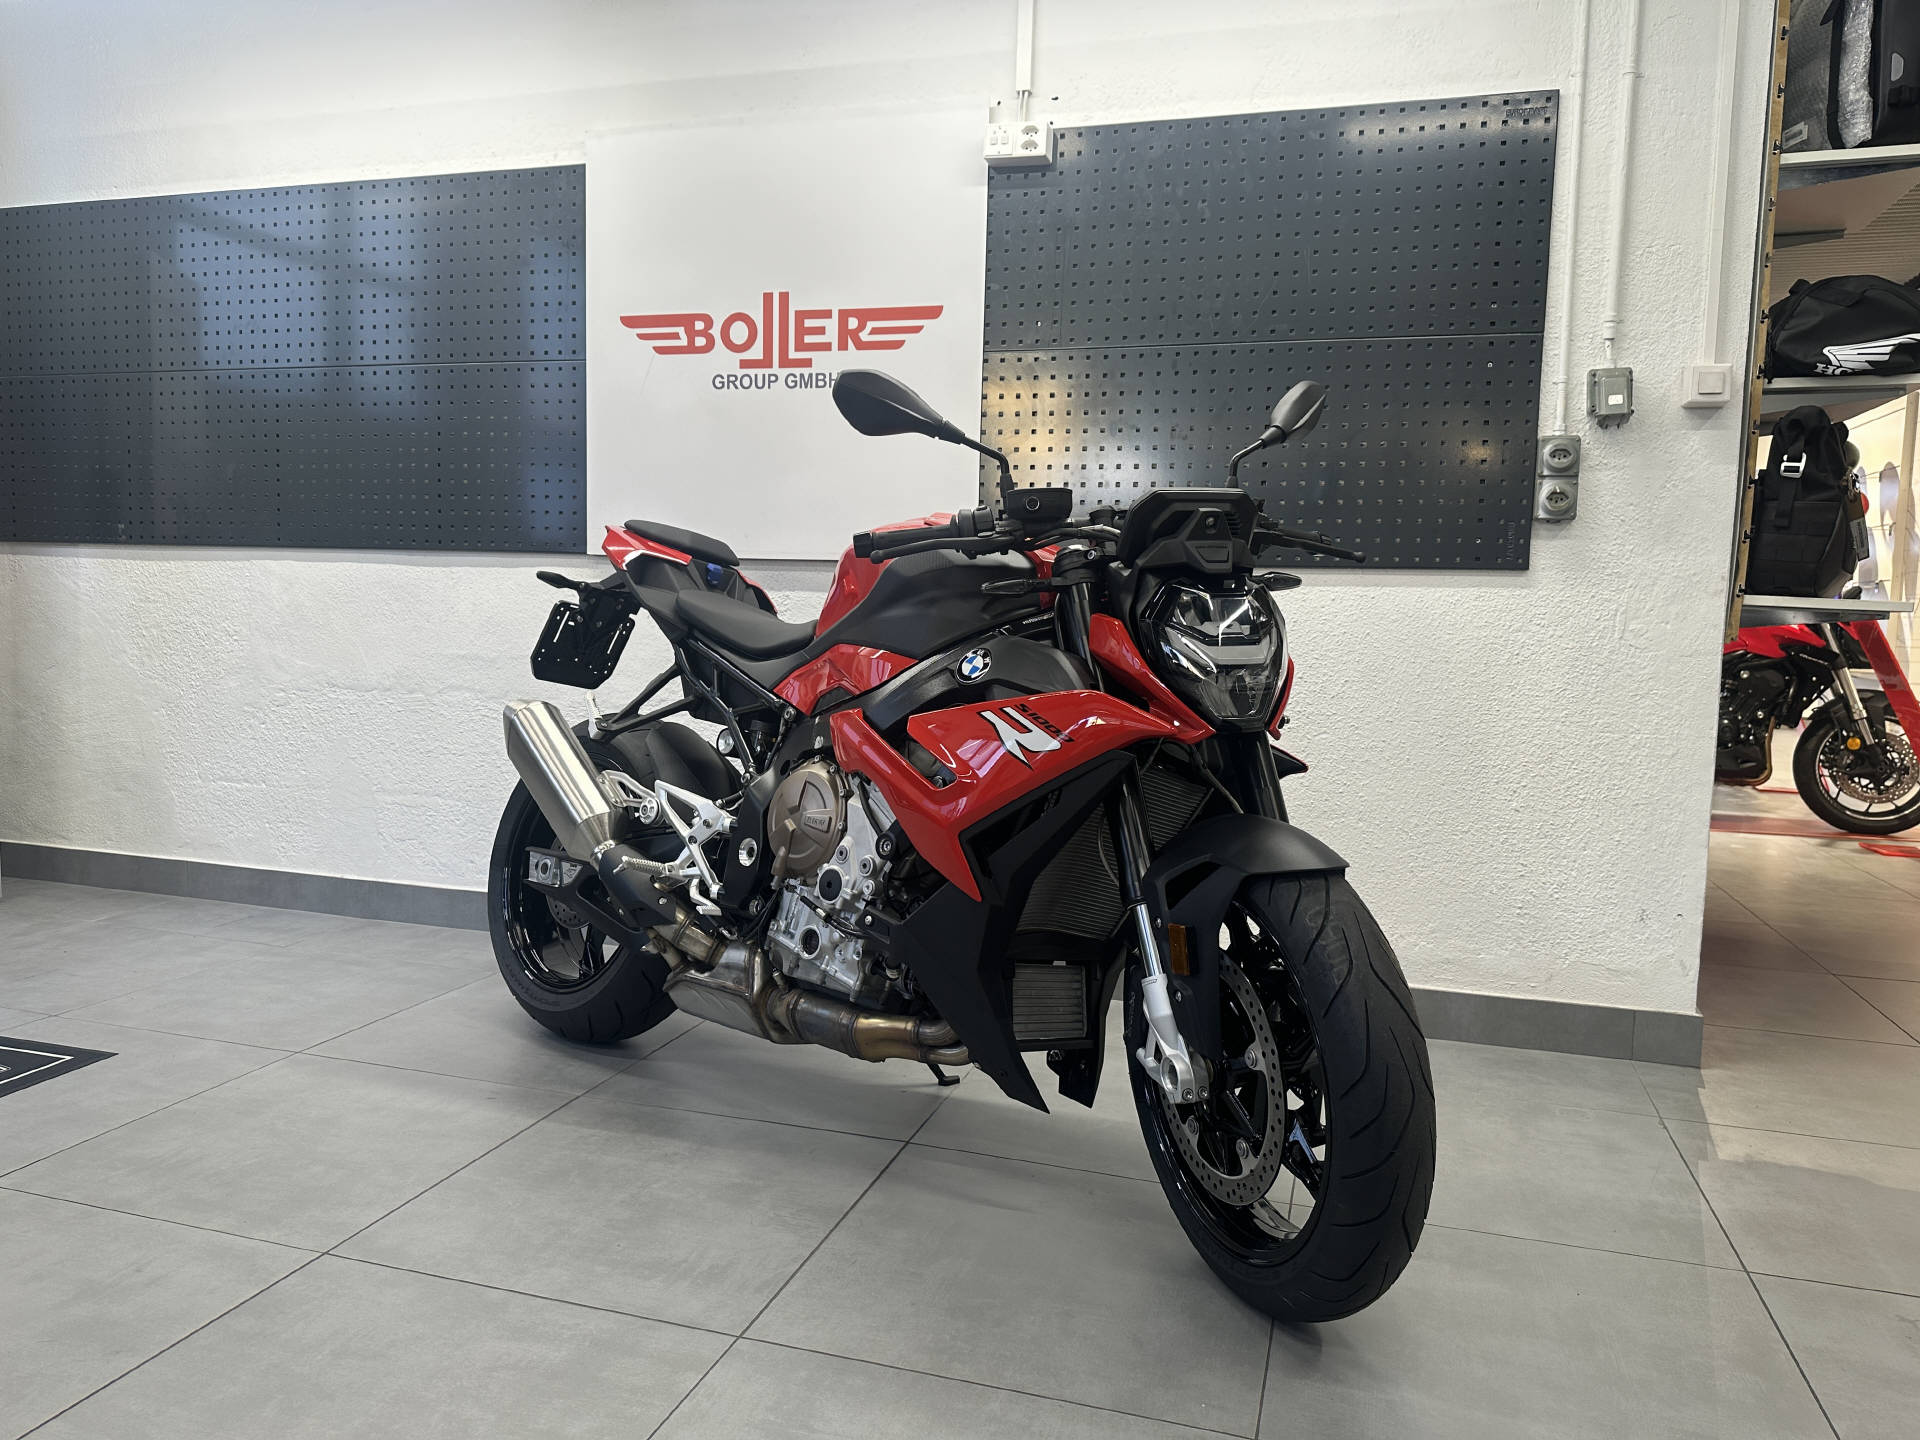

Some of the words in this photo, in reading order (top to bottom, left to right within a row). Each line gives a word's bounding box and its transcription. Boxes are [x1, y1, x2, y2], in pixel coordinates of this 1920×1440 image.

[620, 291, 943, 368] BOLLER
[712, 373, 779, 389] GROUP
[784, 372, 839, 389] GMBH
